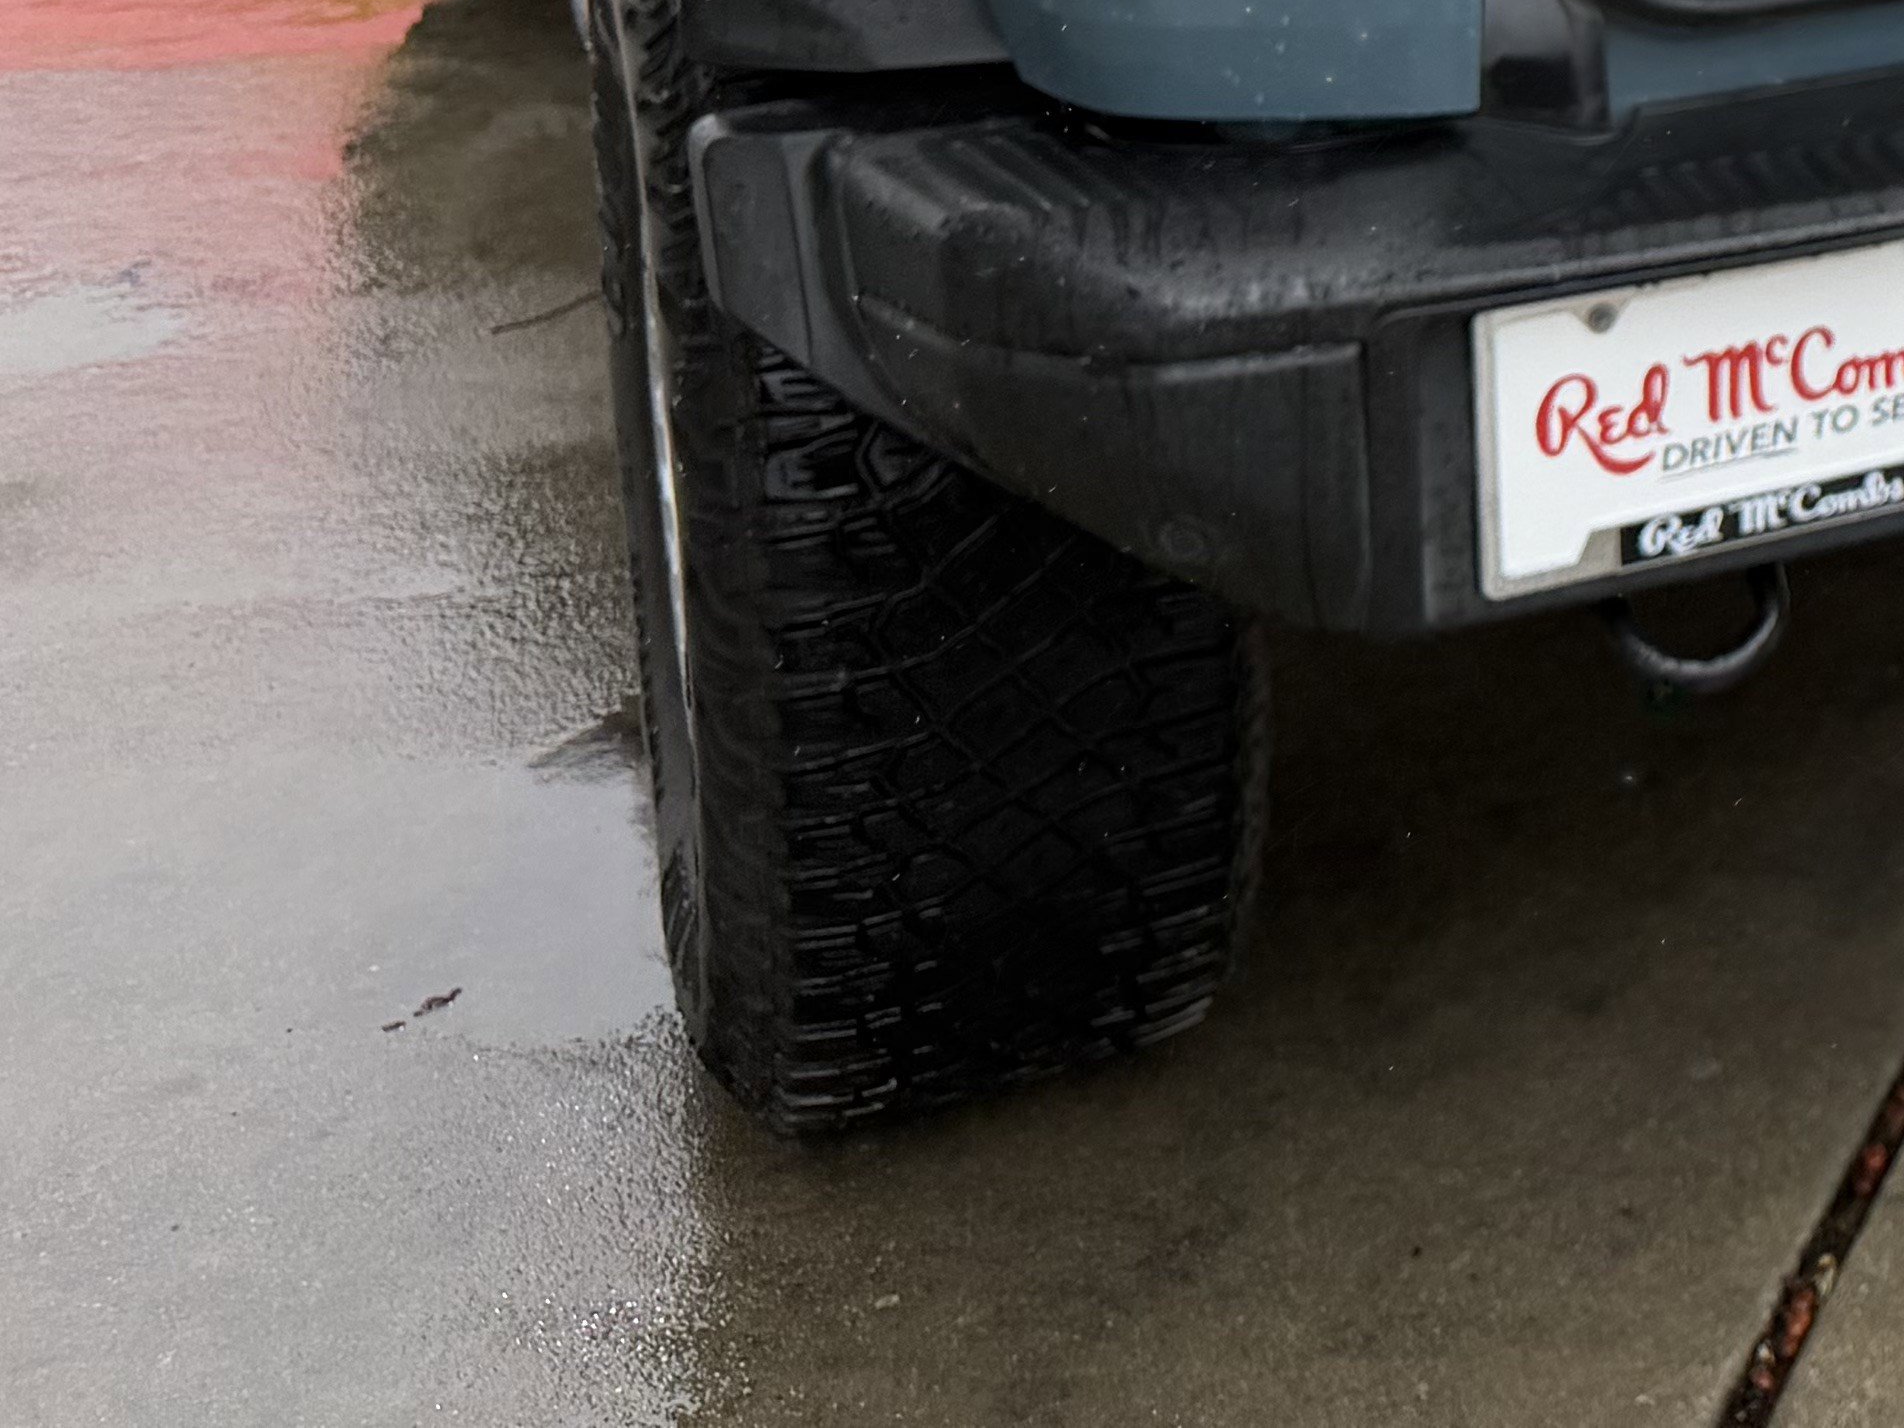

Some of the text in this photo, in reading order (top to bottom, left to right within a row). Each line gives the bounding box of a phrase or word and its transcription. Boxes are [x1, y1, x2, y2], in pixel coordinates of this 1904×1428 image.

[1535, 361, 1670, 476] Red
[1661, 416, 1799, 472] DRIVEN
[1812, 406, 1860, 439] TO
[1638, 504, 1725, 558] Red
